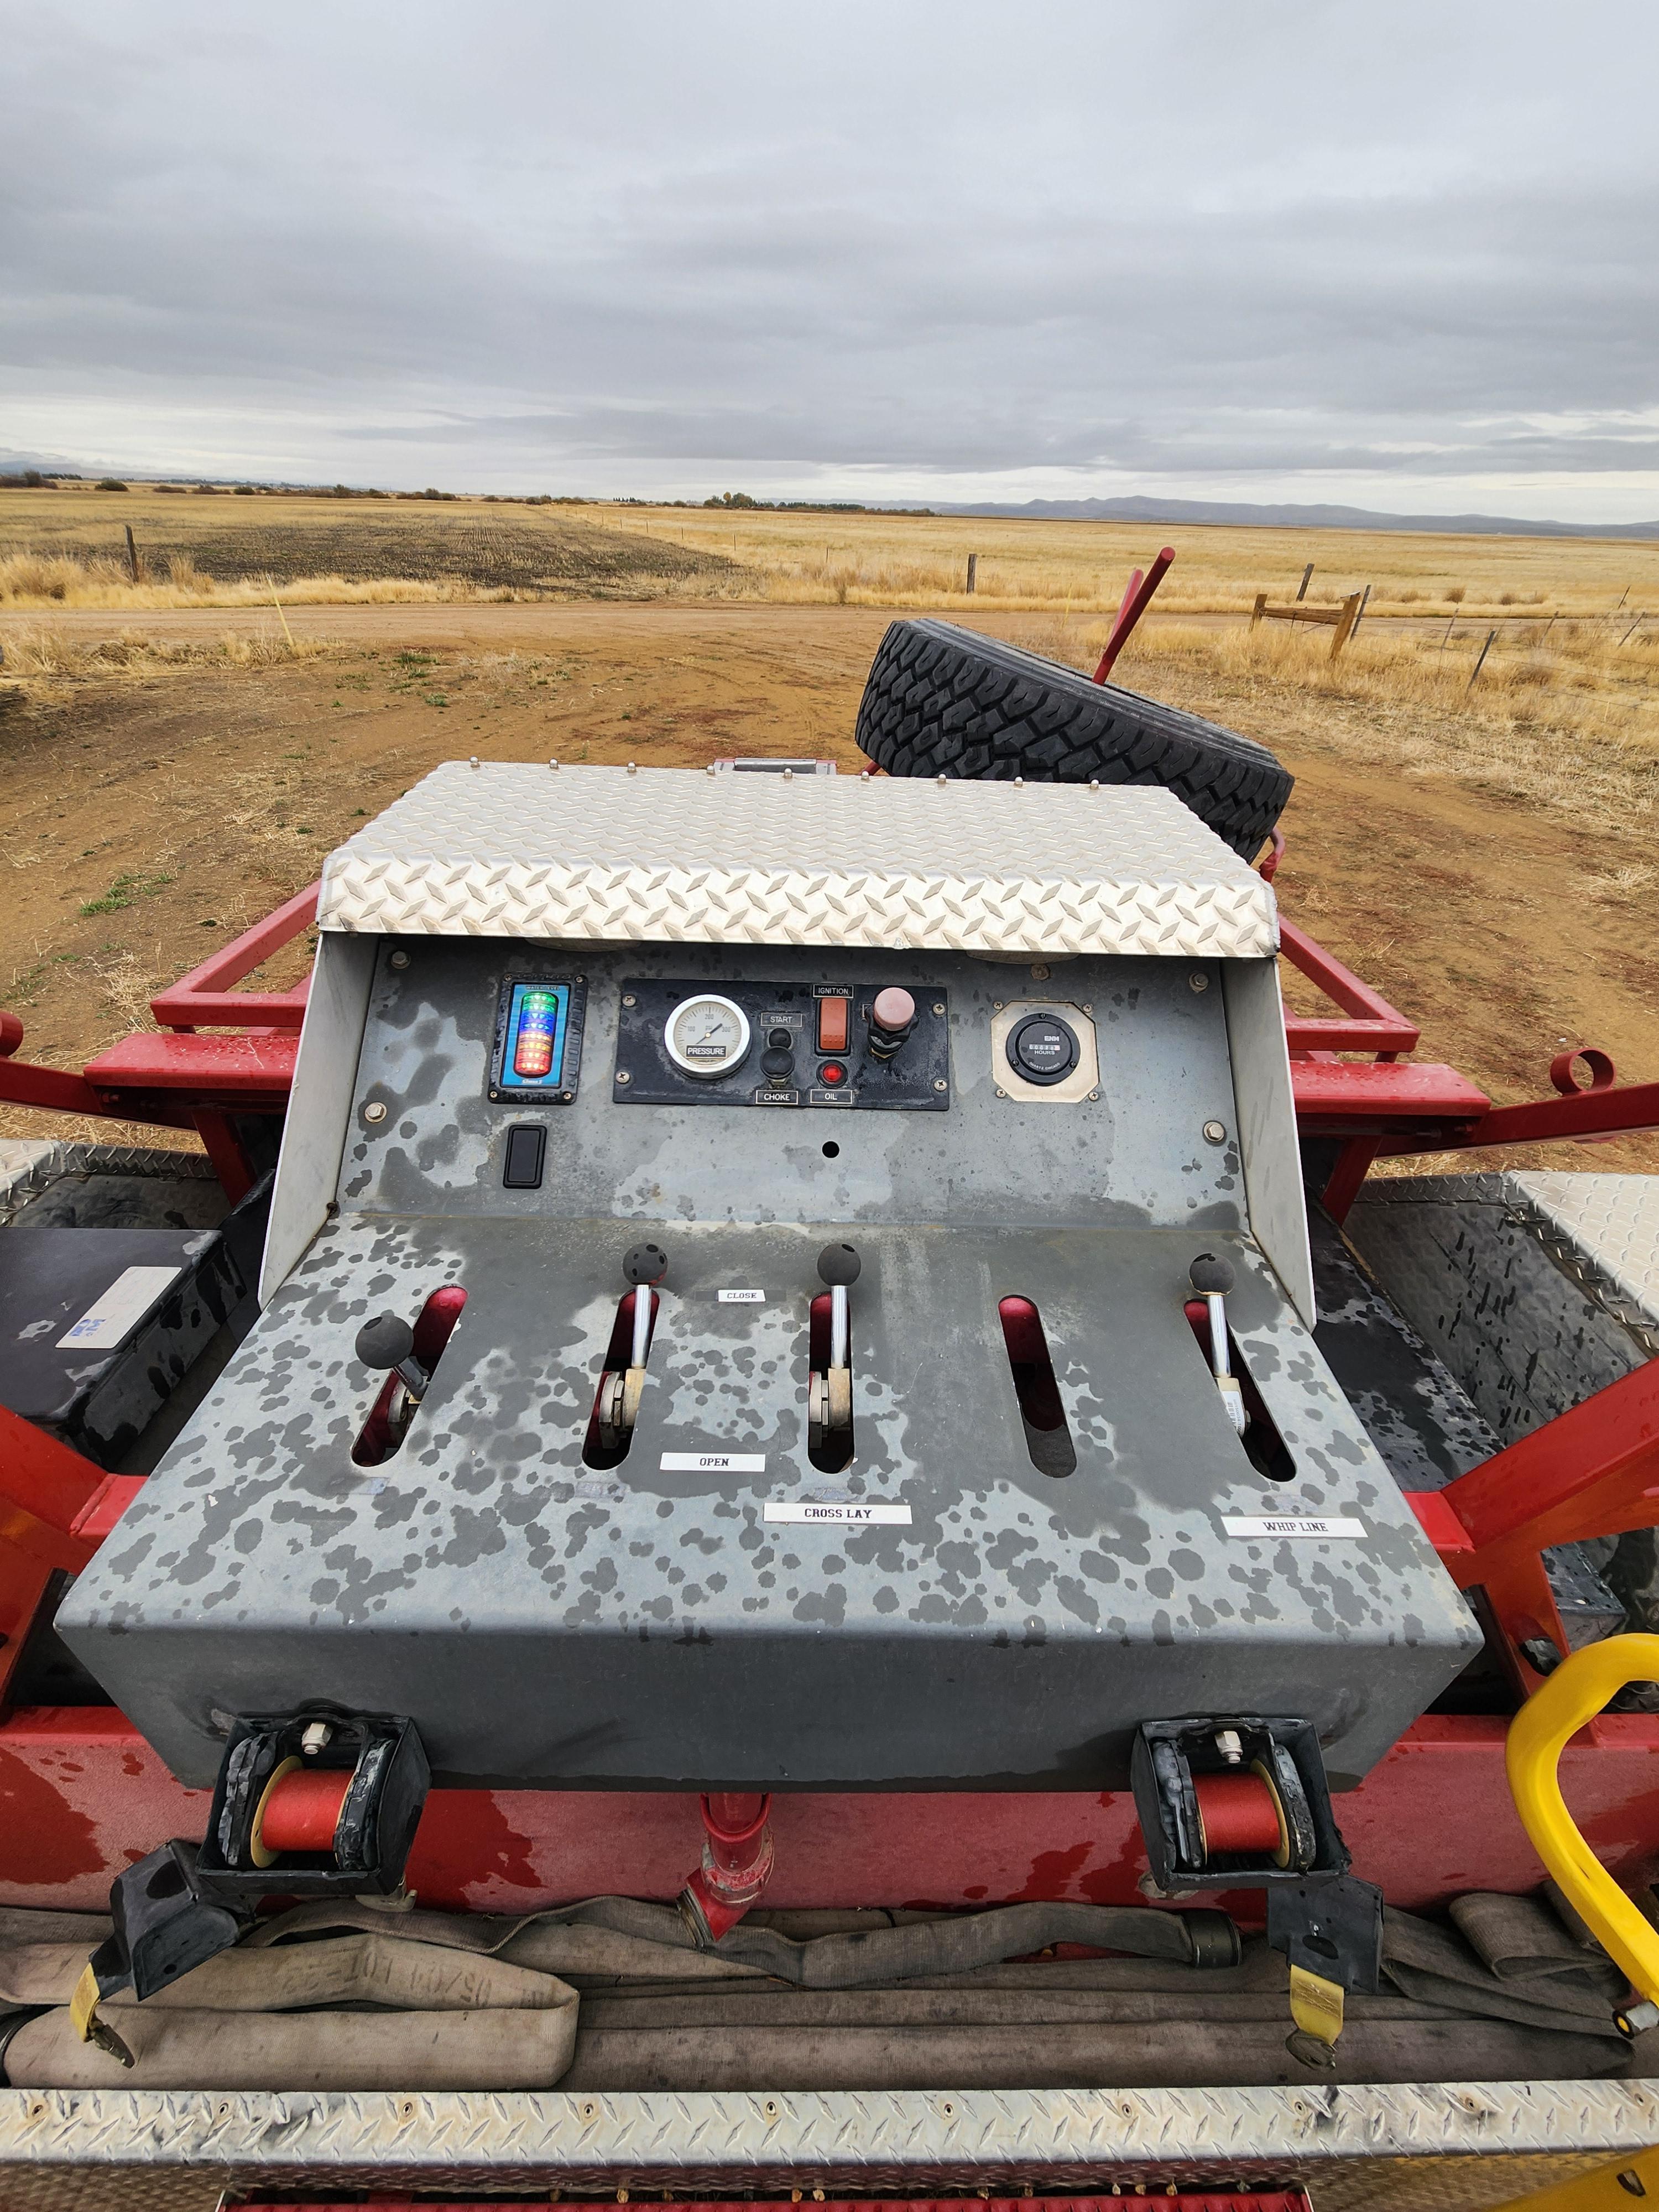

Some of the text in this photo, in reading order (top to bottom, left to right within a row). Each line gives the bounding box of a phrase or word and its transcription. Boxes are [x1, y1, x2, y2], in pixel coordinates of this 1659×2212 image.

[699, 1458, 729, 1467] OPEN
[804, 1508, 873, 1519] CROSS LAY
[1262, 1522, 1329, 1532] WHIP LINE
